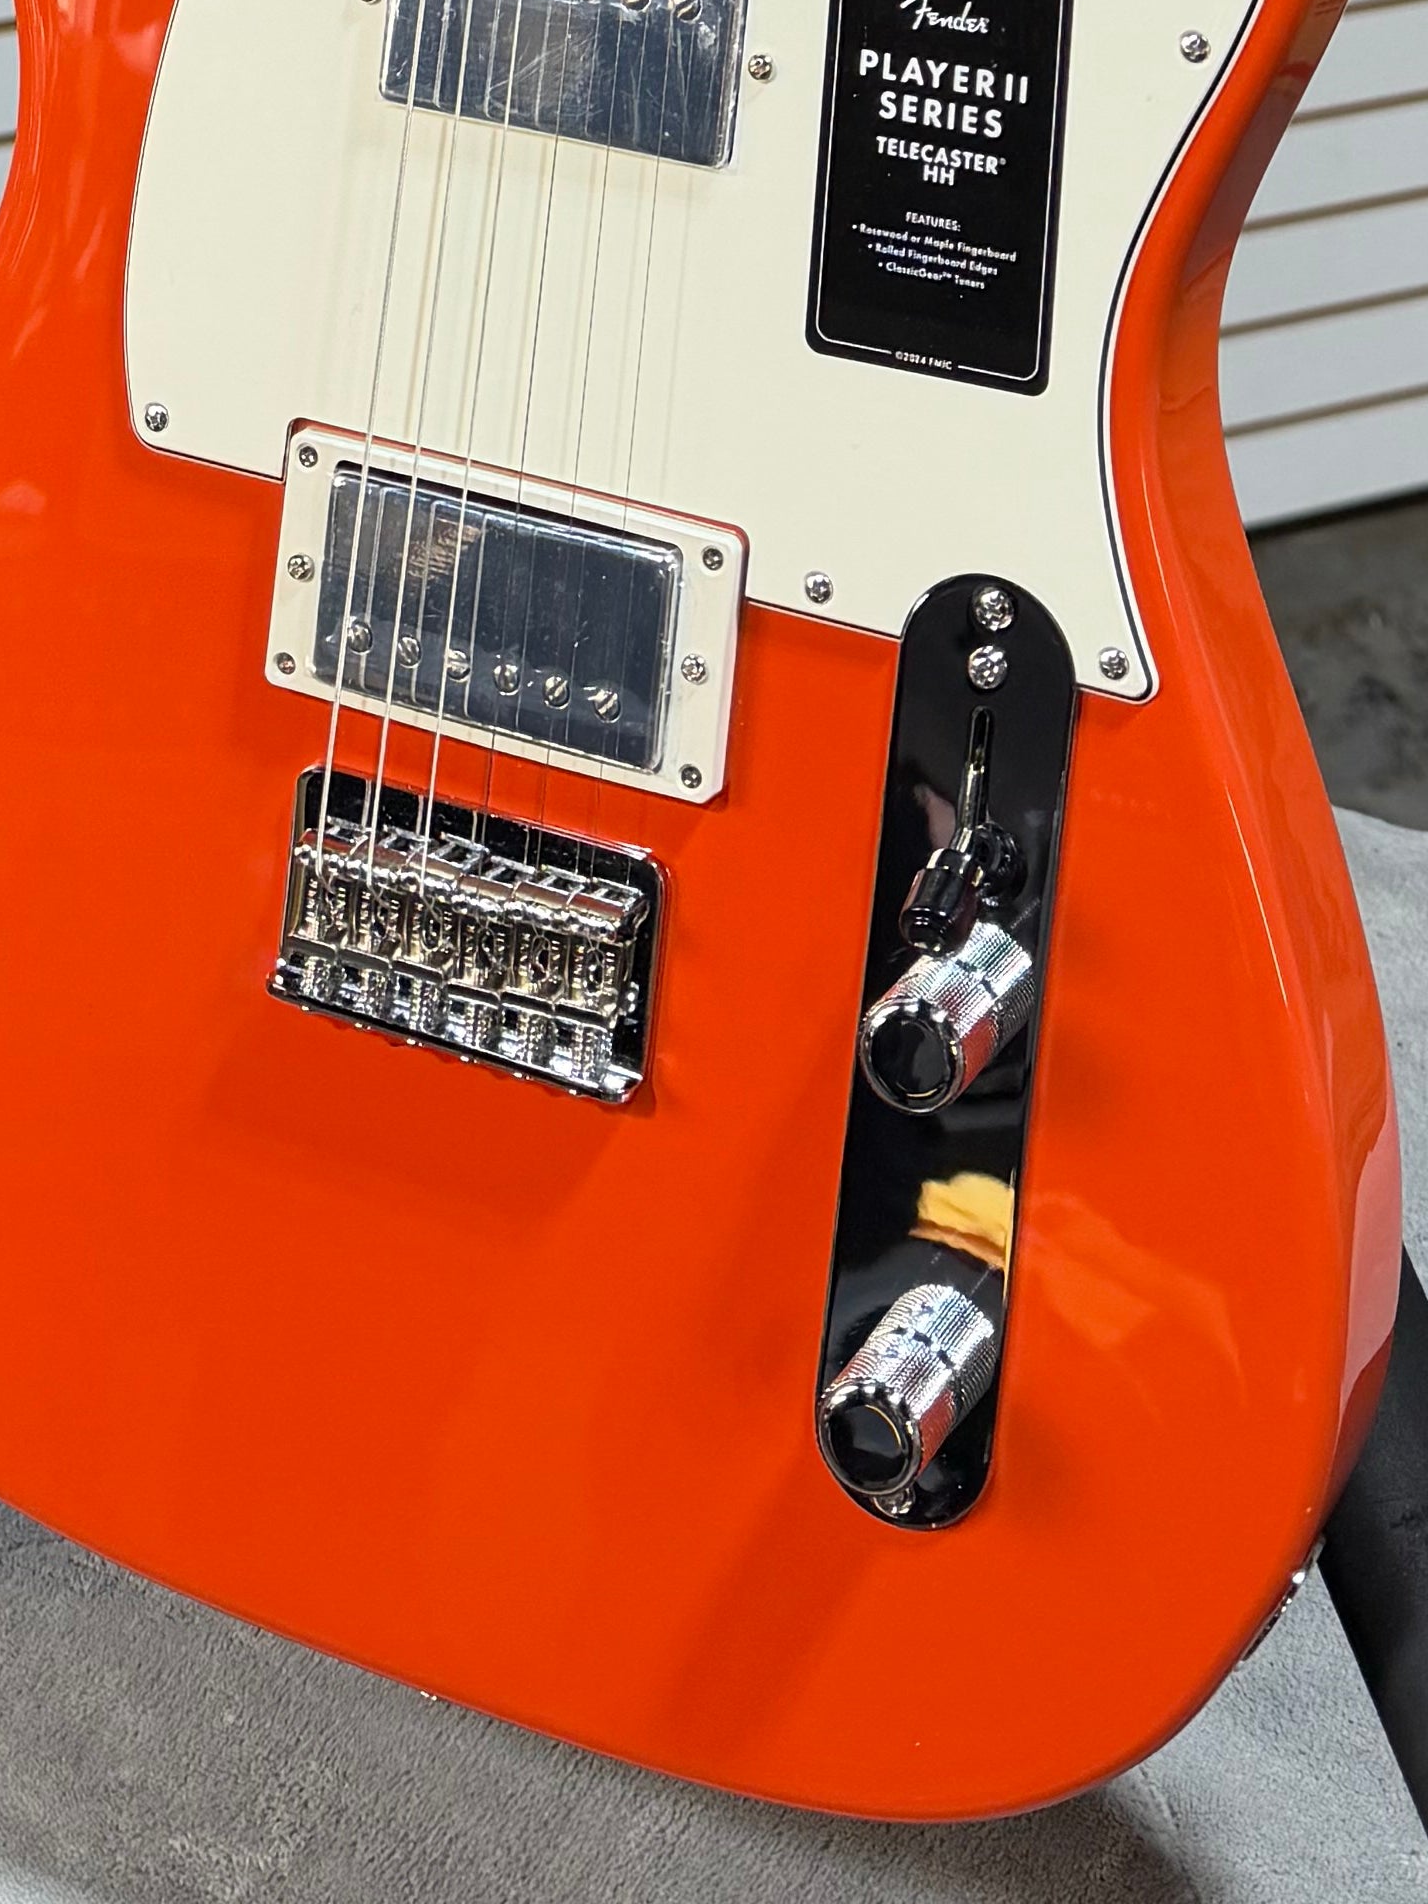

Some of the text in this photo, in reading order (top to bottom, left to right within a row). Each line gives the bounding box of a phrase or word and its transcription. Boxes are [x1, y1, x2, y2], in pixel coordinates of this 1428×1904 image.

[859, 48, 995, 99] PLAYER
[878, 90, 1003, 139] SERIES
[923, 164, 955, 186] HH
[905, 211, 961, 232] FEATURES:
[860, 223, 1017, 263] Rosewood or Maple Fingerboard
[875, 243, 998, 276] Rolled Fingerboard Edges
[954, 274, 985, 290] Tuners
